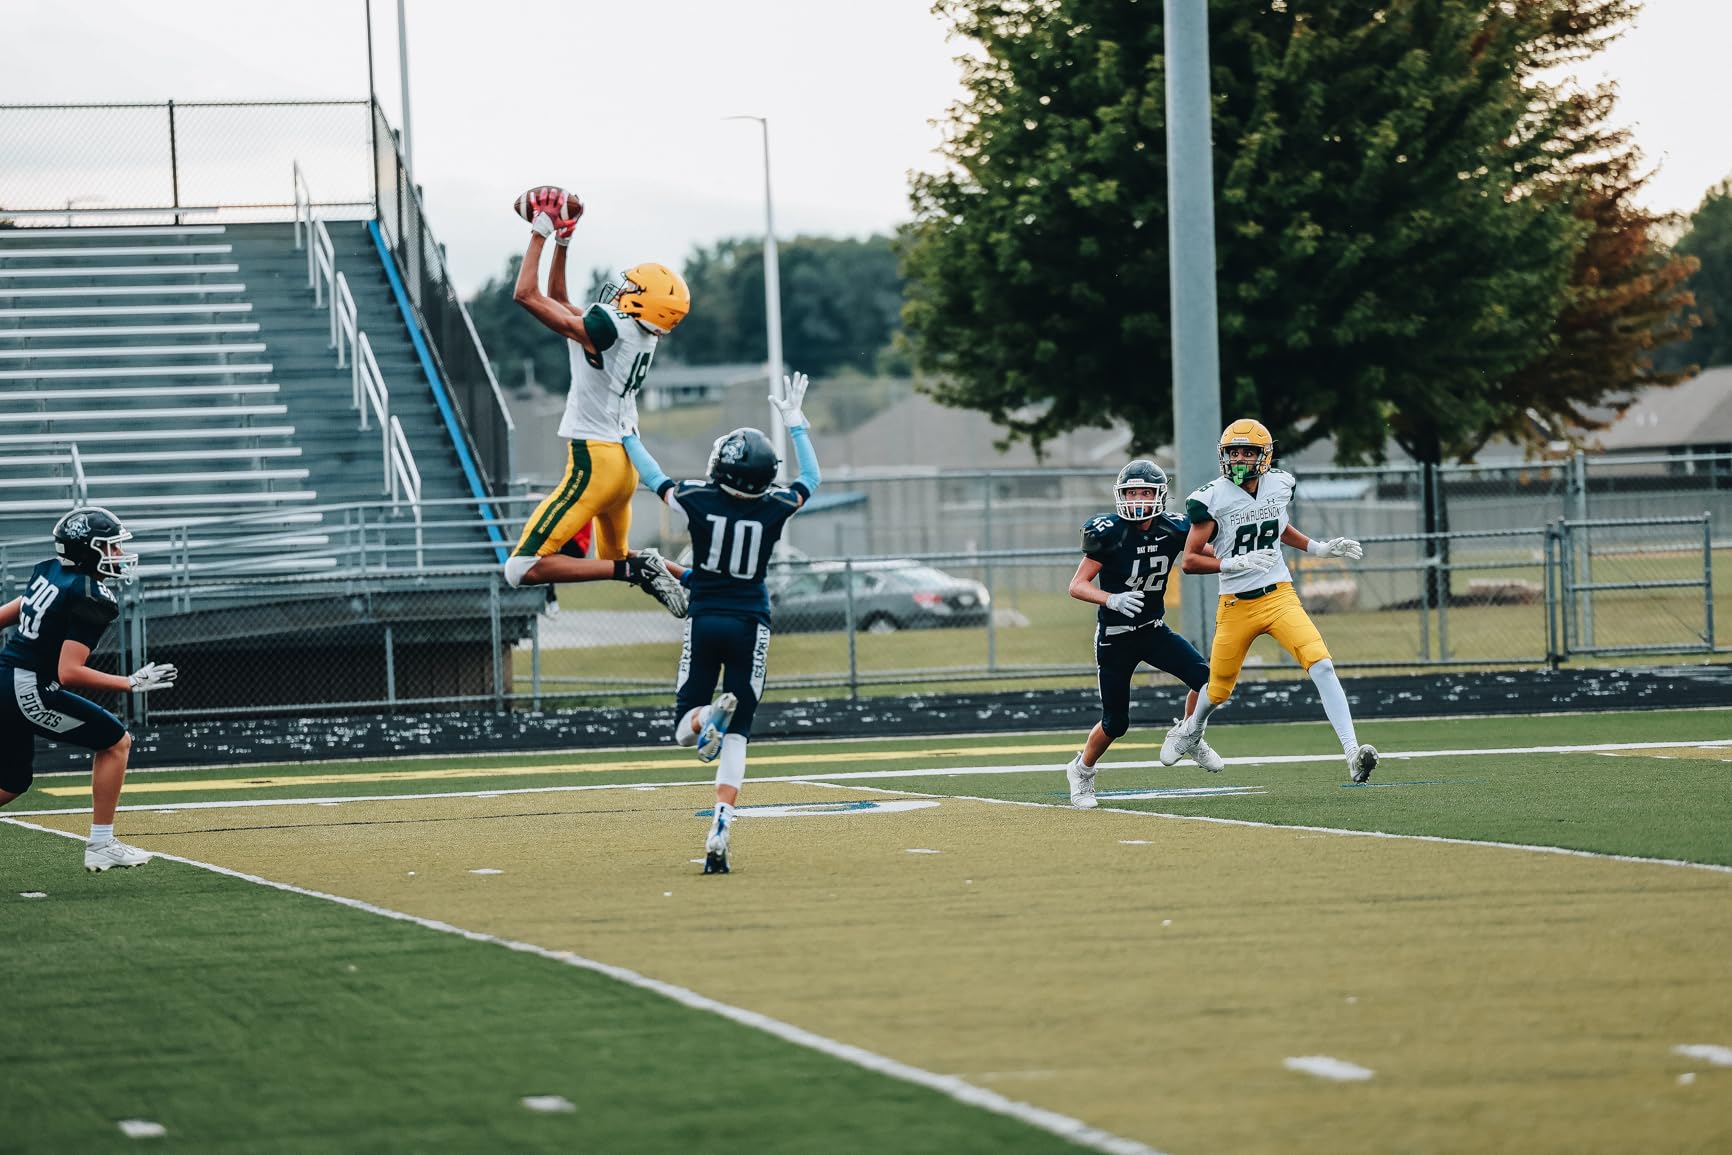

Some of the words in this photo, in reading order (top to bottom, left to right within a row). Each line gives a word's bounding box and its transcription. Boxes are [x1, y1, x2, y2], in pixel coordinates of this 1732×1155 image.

[701, 514, 763, 580] 10
[1124, 555, 1170, 592] 42
[19, 691, 63, 730] PIRATES
